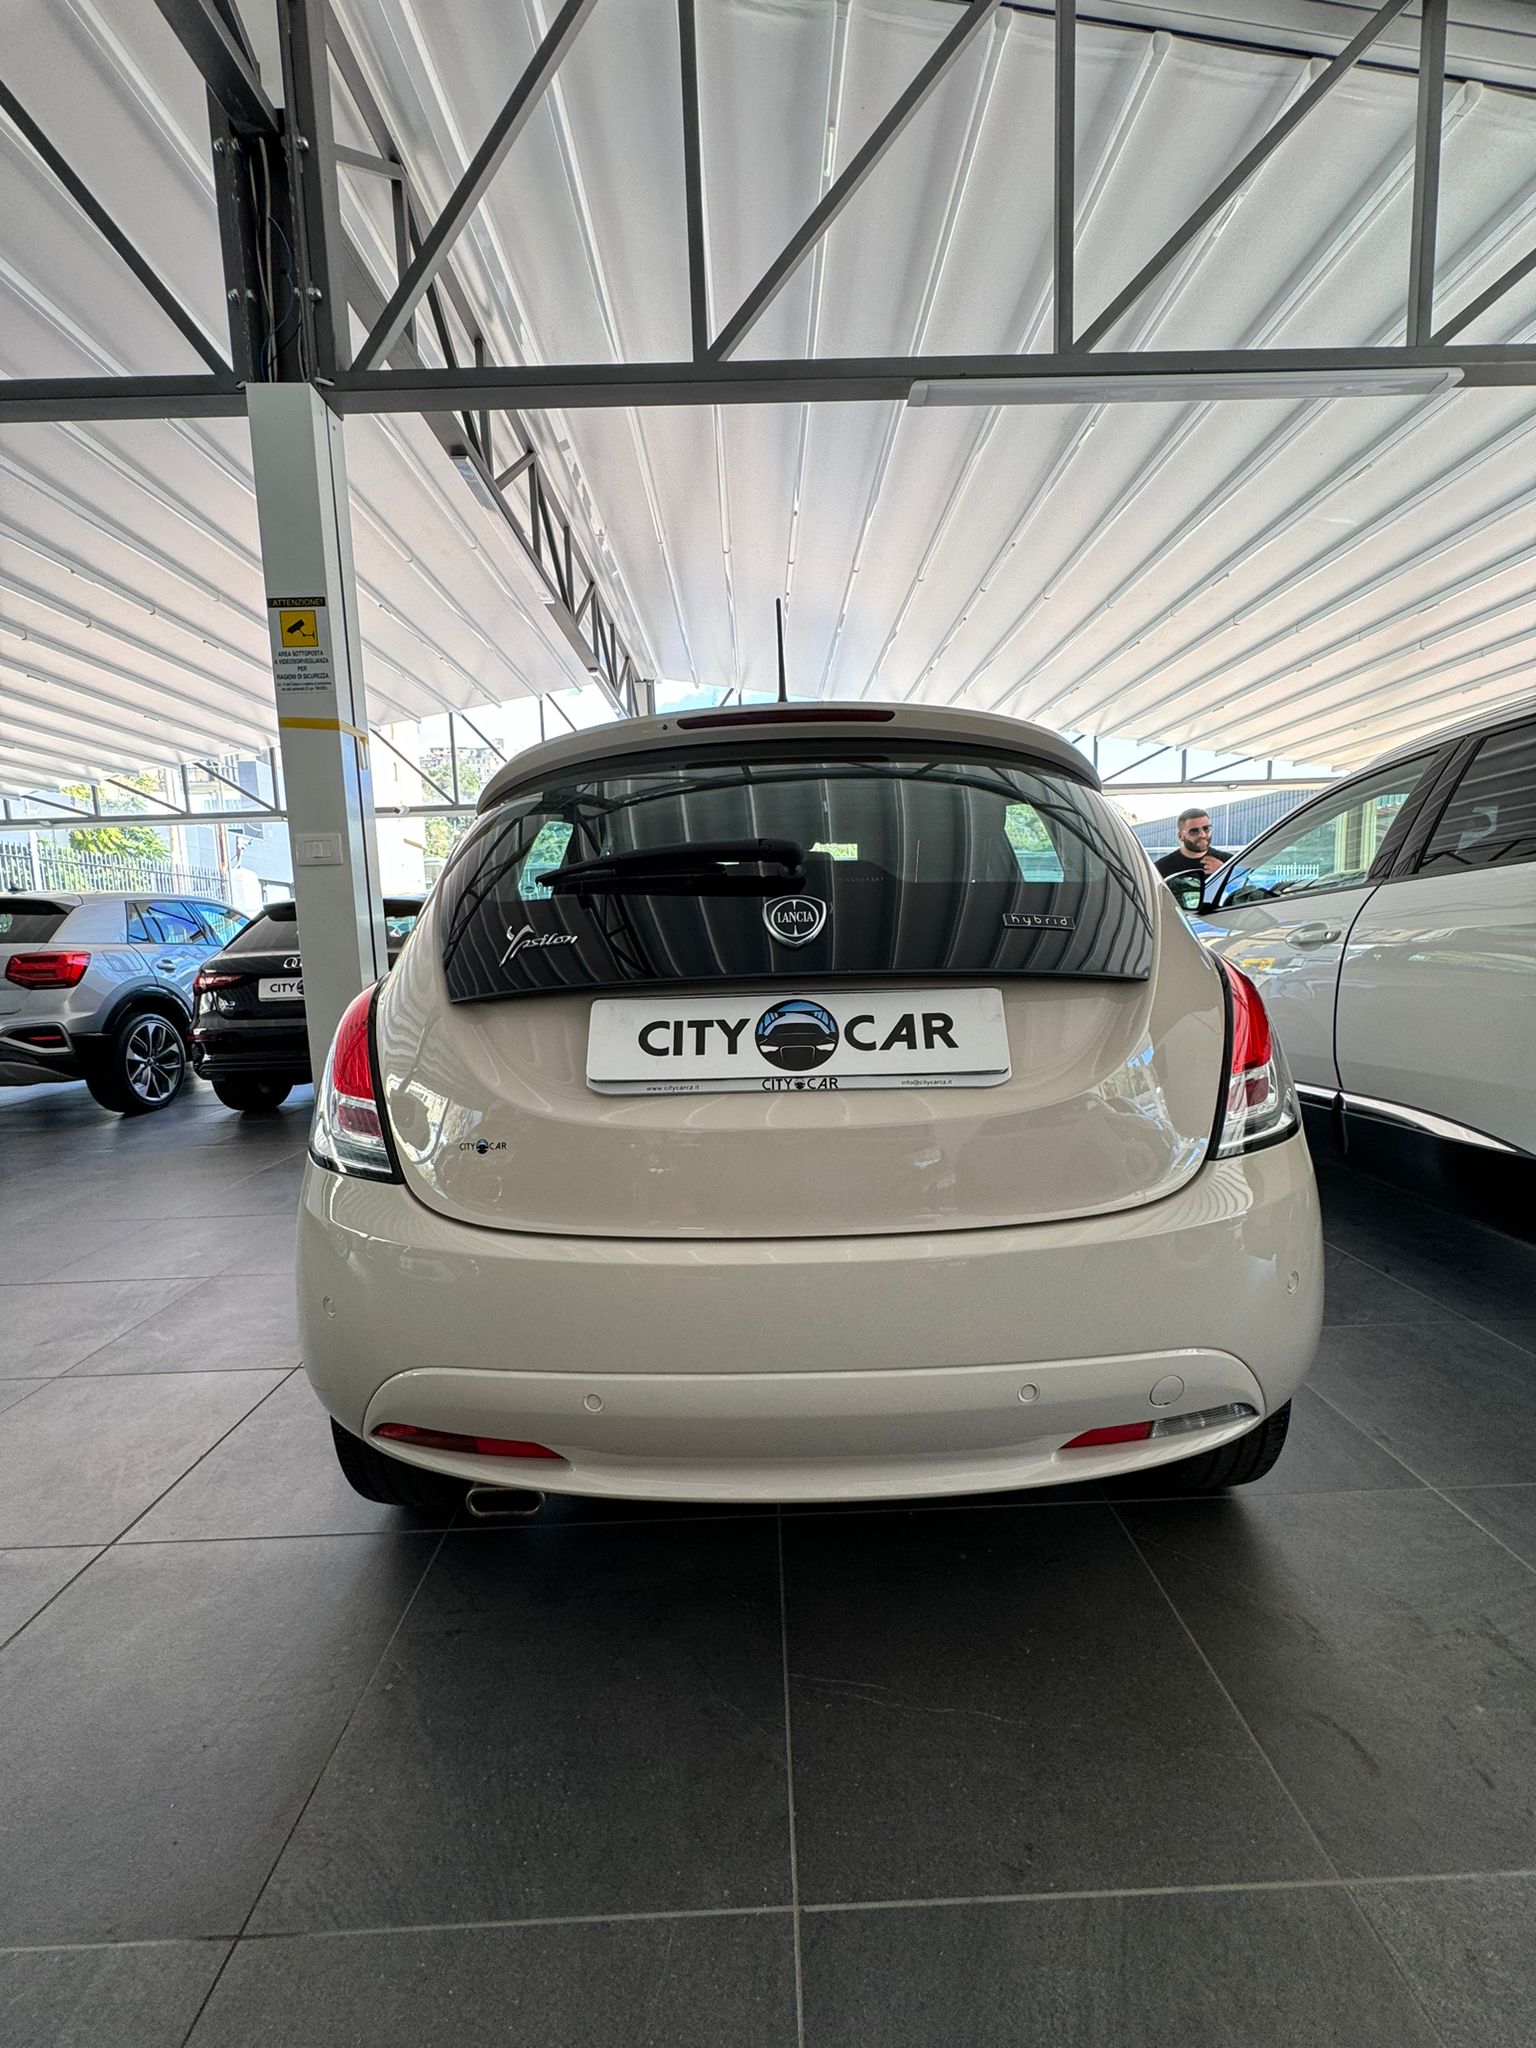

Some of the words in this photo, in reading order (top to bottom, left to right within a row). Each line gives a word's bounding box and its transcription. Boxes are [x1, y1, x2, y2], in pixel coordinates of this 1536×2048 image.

[272, 598, 324, 607] ATTENZIONE!
[777, 911, 814, 923] LANCIA
[1010, 914, 1068, 926] hybrid
[499, 924, 578, 967] Ypsilon
[270, 983, 296, 993] CITY
[638, 1018, 751, 1057] CITY
[844, 1012, 960, 1051] CAR
[762, 1078, 792, 1090] CITY
[807, 1077, 839, 1089] CAR
[459, 1142, 475, 1151] CITY
[490, 1141, 507, 1150] CAR
